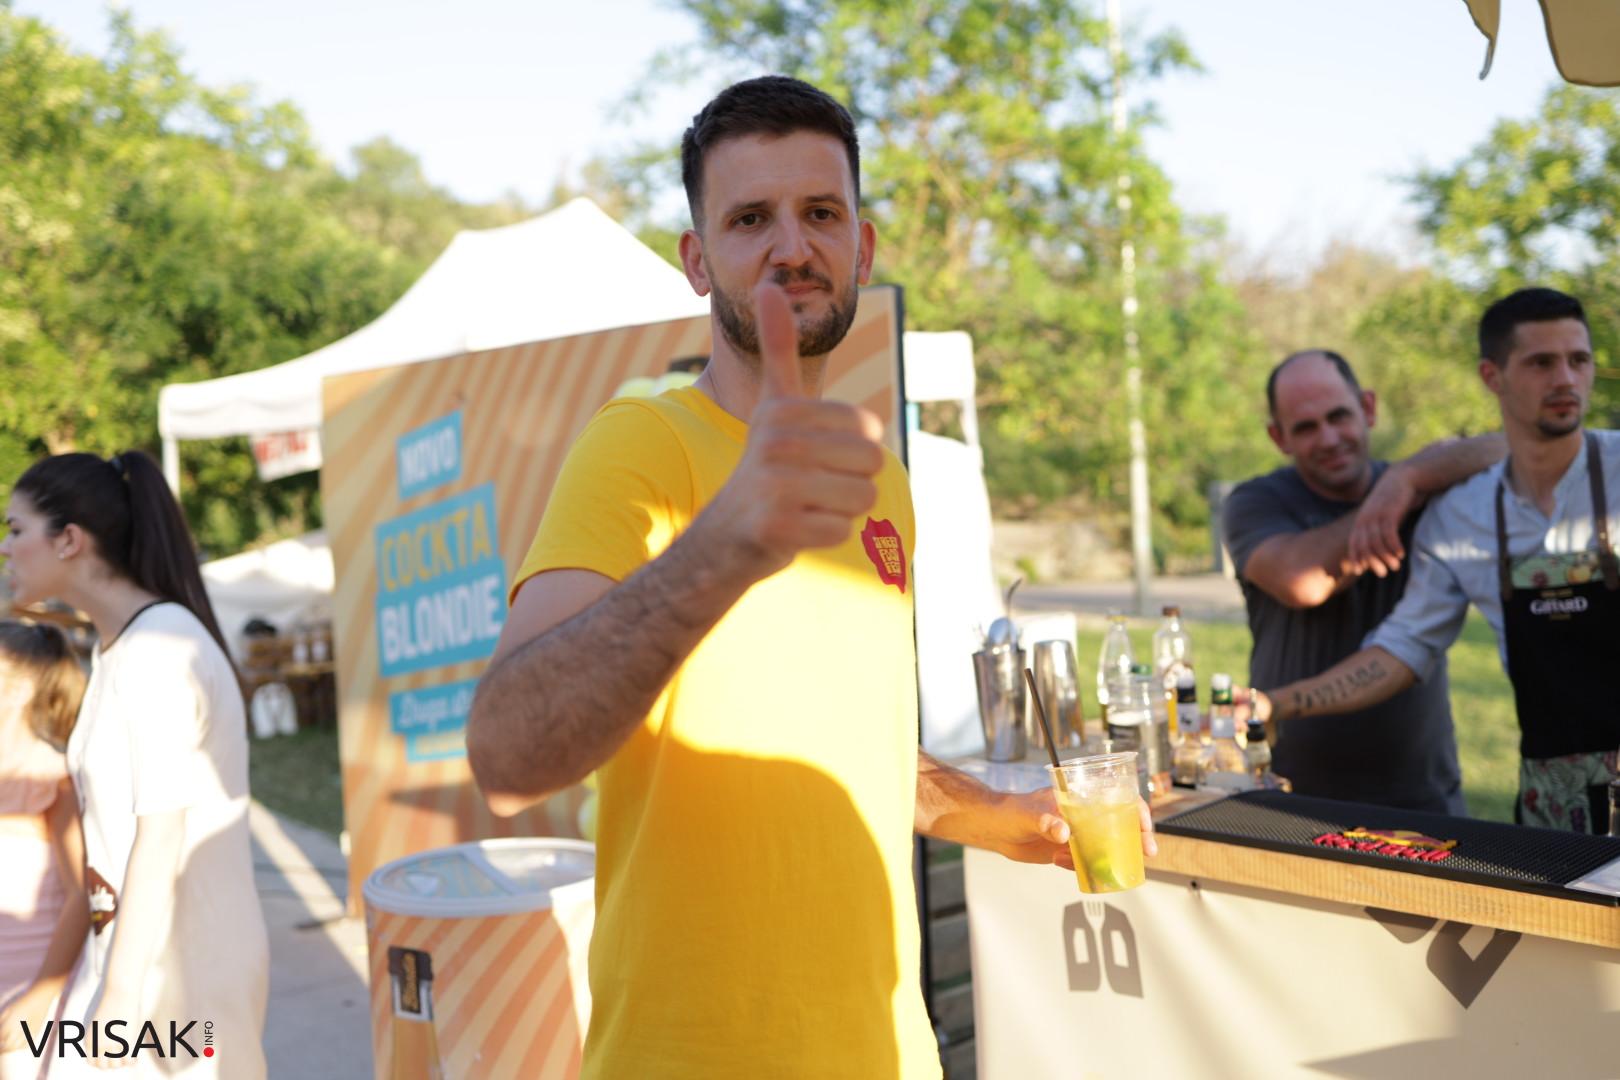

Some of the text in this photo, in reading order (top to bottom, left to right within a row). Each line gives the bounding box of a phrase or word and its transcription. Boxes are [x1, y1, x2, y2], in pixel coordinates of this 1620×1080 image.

[401, 426, 456, 486] NOVO
[382, 502, 493, 592] COCKTA
[381, 573, 501, 664] BLONDIE
